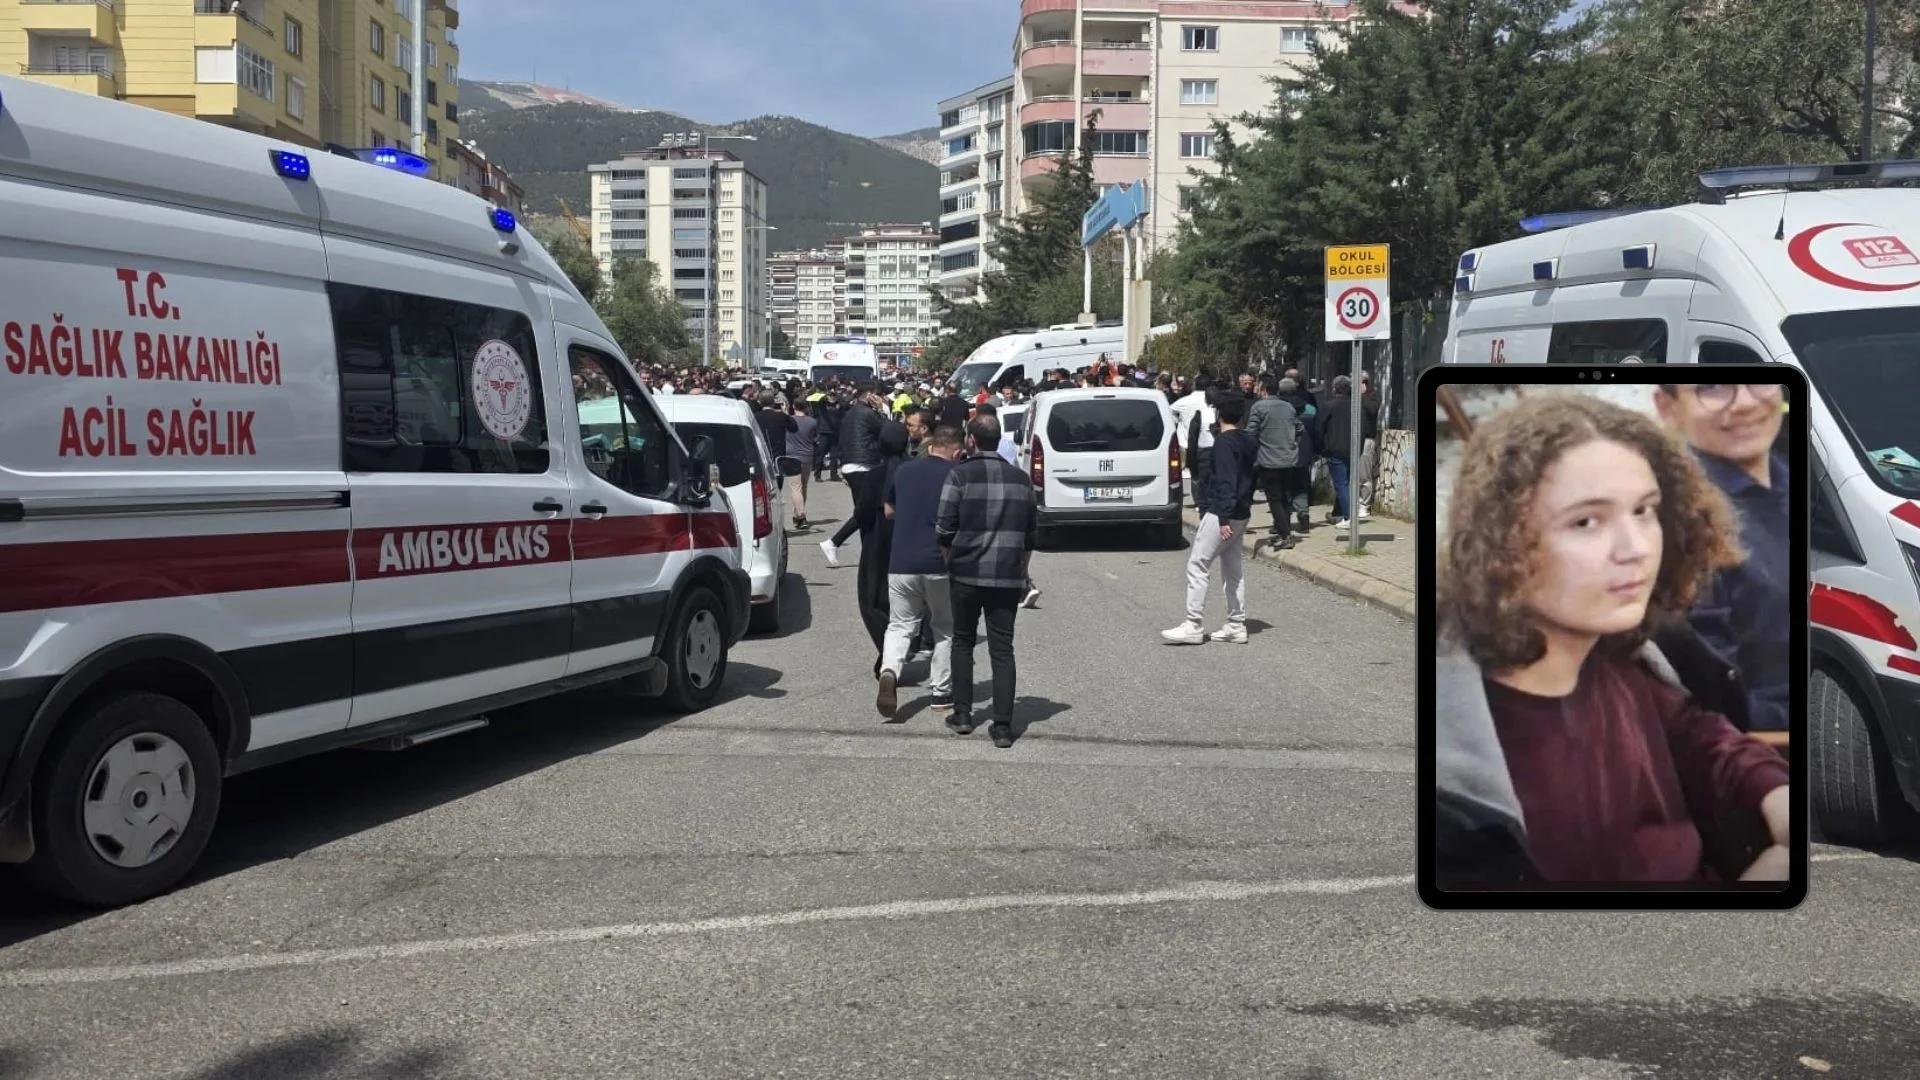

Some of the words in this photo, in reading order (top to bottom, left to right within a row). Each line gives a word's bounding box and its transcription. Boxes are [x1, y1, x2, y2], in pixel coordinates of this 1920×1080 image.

[1339, 252, 1375, 261] OKUL
[1853, 240, 1903, 255] 112
[1329, 262, 1385, 275] BÖLGESİ
[116, 268, 181, 320] T.C.
[1345, 298, 1370, 317] 30
[4, 313, 127, 379] SAĞLIK
[134, 330, 282, 385] BAKANLIĞI
[58, 395, 137, 457] ACİL
[146, 398, 257, 456] SAĞLIK
[1099, 459, 1114, 472] FIAT
[378, 524, 550, 573] AMBULANS
